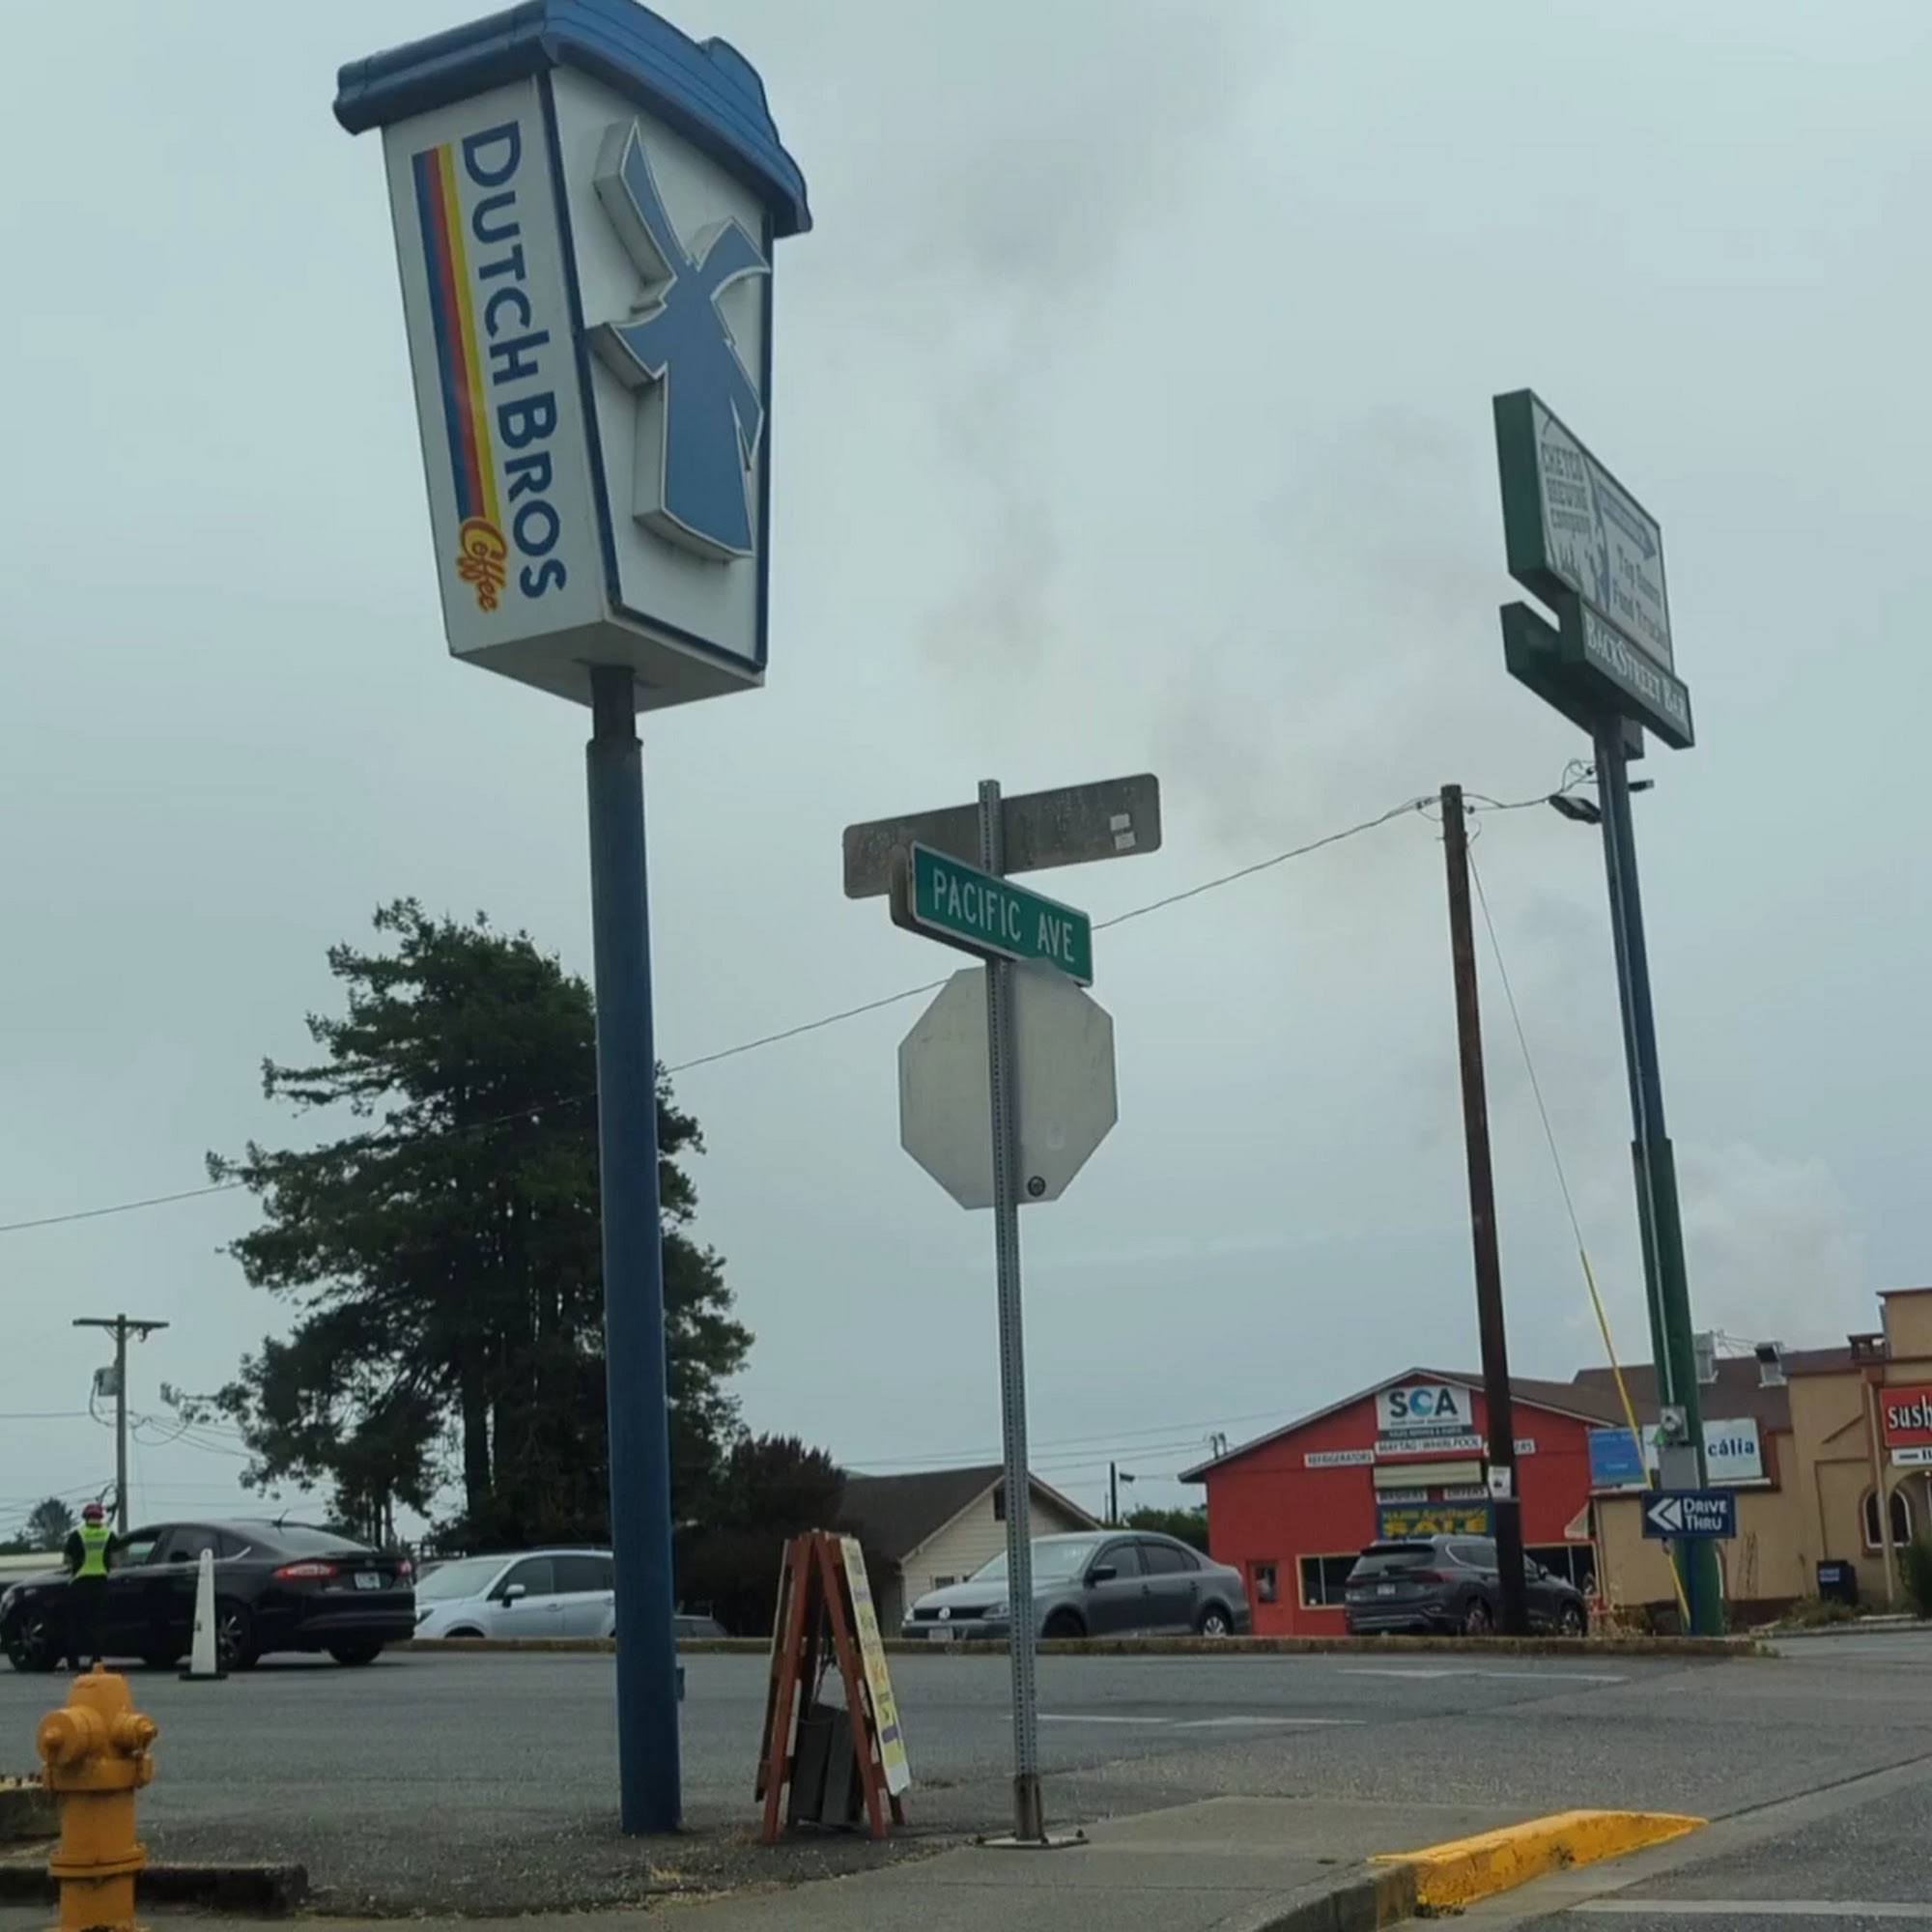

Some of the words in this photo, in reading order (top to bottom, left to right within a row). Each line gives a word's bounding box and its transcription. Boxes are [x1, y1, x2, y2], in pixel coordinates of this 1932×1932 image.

[462, 120, 551, 386] DUTCH
[497, 390, 567, 599] BROS
[457, 517, 508, 611] Coffee
[932, 867, 1021, 944] PACIFIC
[1037, 911, 1075, 963] AVE
[1389, 1387, 1459, 1418] SCA
[1382, 1517, 1488, 1539] SALE
[1683, 1497, 1727, 1515] DRIVE
[1685, 1514, 1723, 1531] THRU
